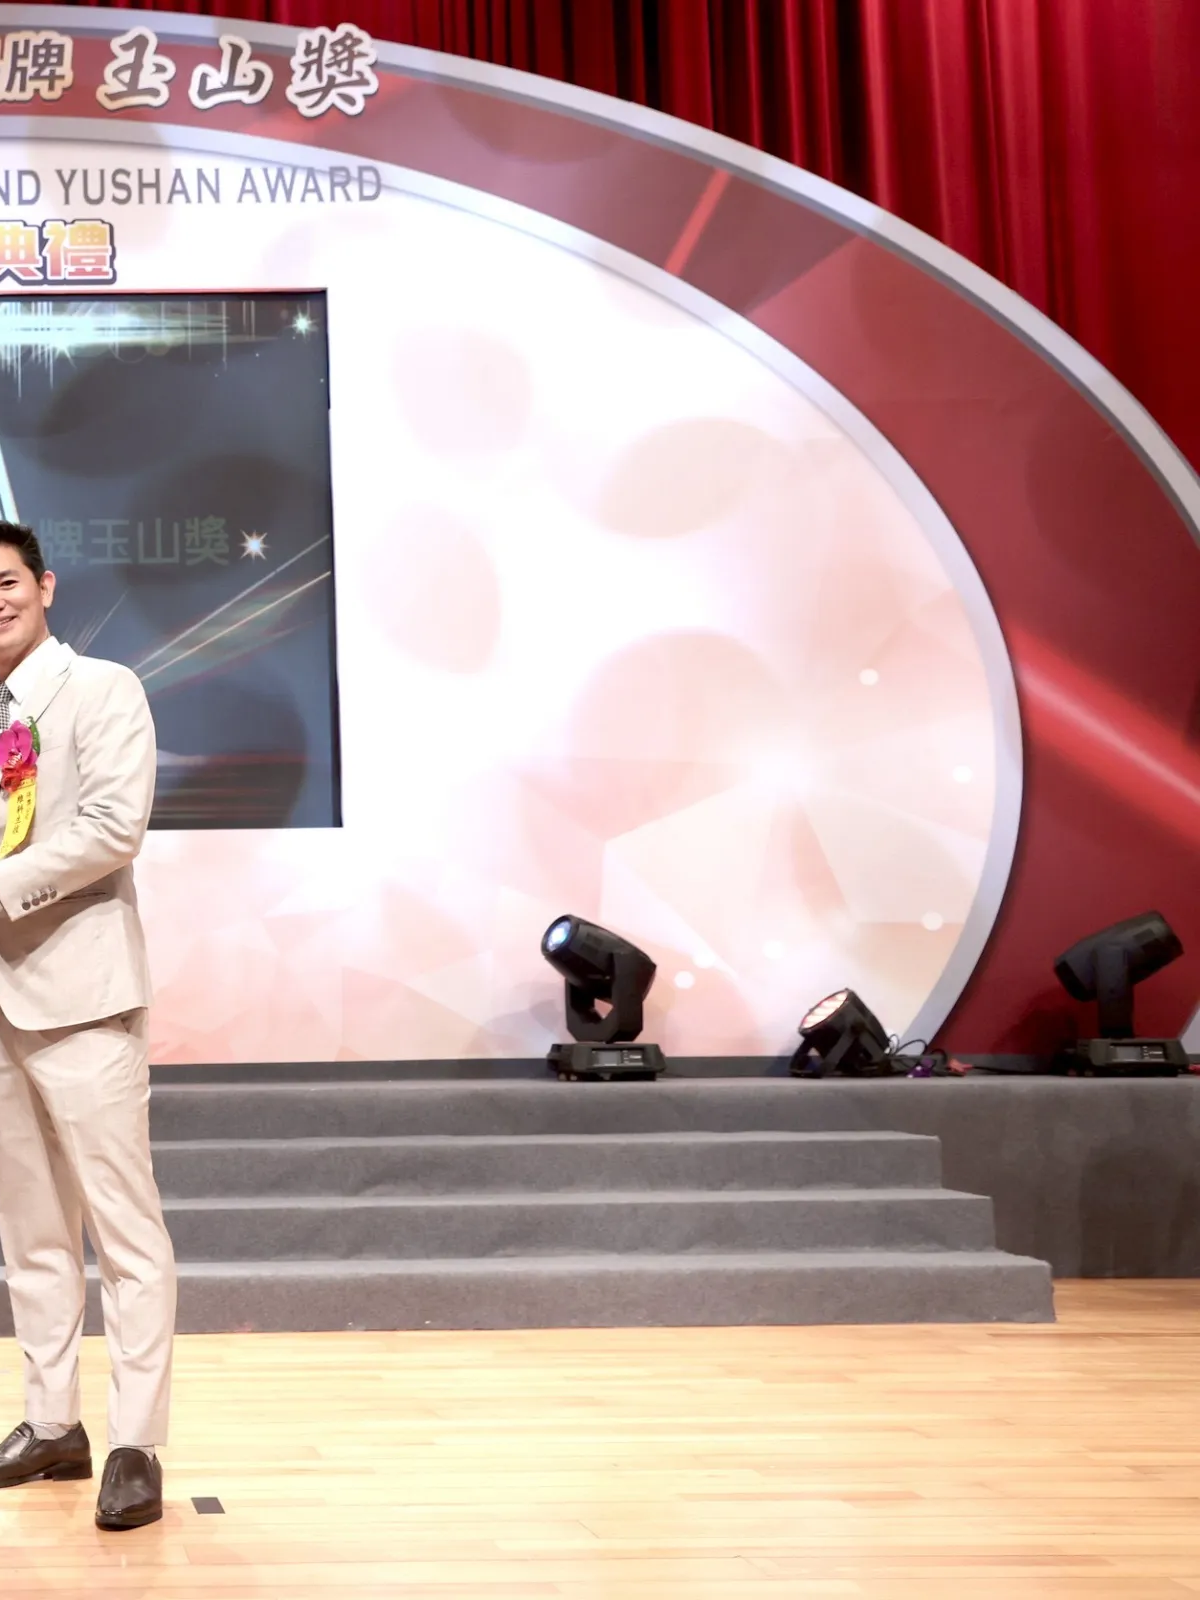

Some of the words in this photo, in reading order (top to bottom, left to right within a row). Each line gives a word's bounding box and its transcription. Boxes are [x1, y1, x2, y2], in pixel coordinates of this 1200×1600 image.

[103, 30, 371, 111] 玉山獎
[55, 168, 222, 206] YUSHAN
[236, 165, 383, 204] AWARD
